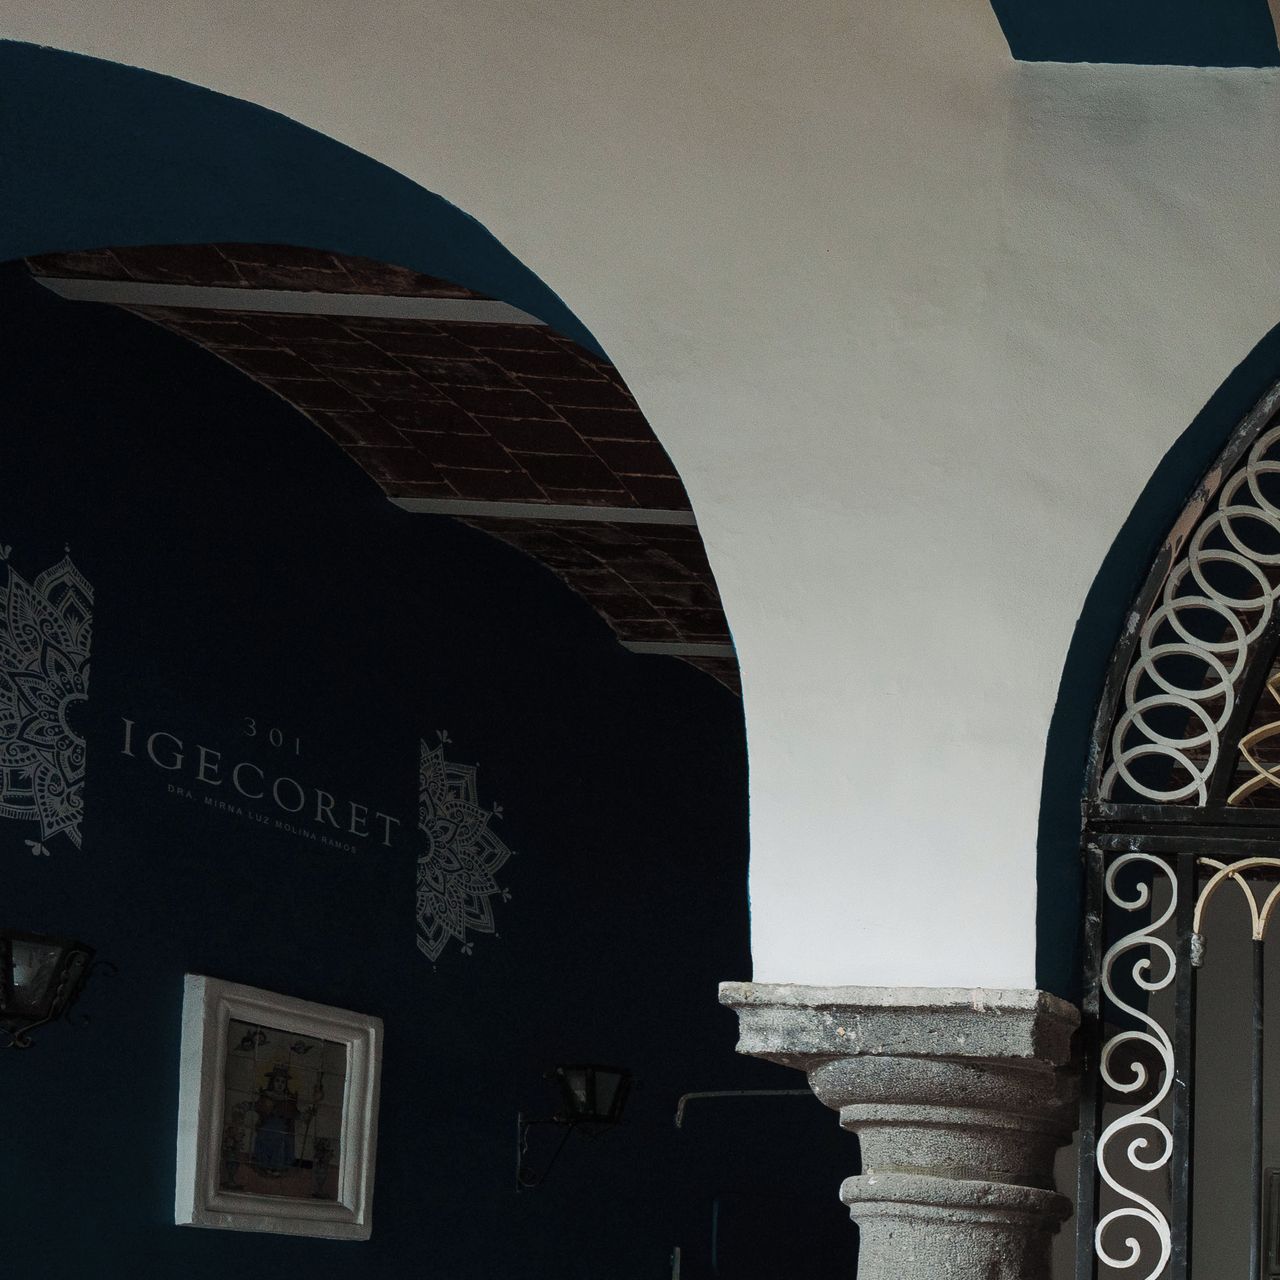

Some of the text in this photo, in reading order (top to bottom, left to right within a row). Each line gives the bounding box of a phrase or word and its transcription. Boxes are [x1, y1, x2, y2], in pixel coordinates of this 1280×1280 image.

[245, 716, 300, 756] 301
[120, 716, 400, 848] IGECORET
[167, 783, 357, 854] DRA. MIRNA LUZ MOLINA RAMOS
